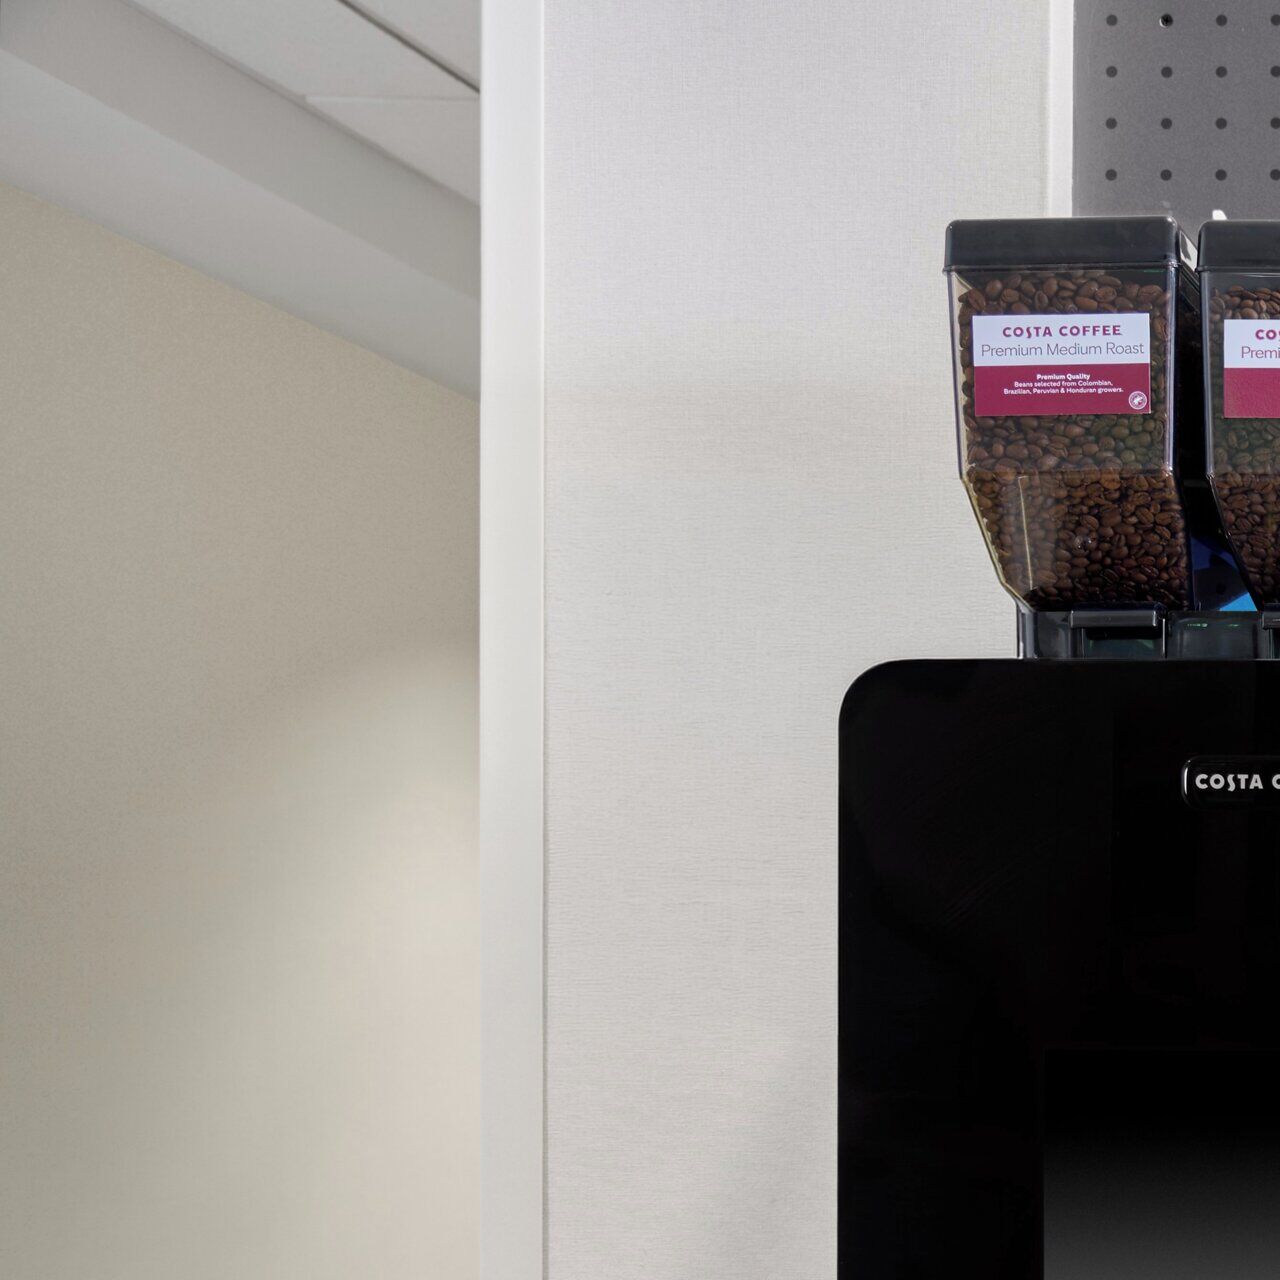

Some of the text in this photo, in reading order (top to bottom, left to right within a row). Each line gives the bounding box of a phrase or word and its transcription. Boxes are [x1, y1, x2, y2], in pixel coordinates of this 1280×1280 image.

[1003, 325, 1121, 338] COSTA COFFEE
[981, 342, 1144, 357] Premium Medium Roast
[1195, 774, 1263, 791] COSTA
